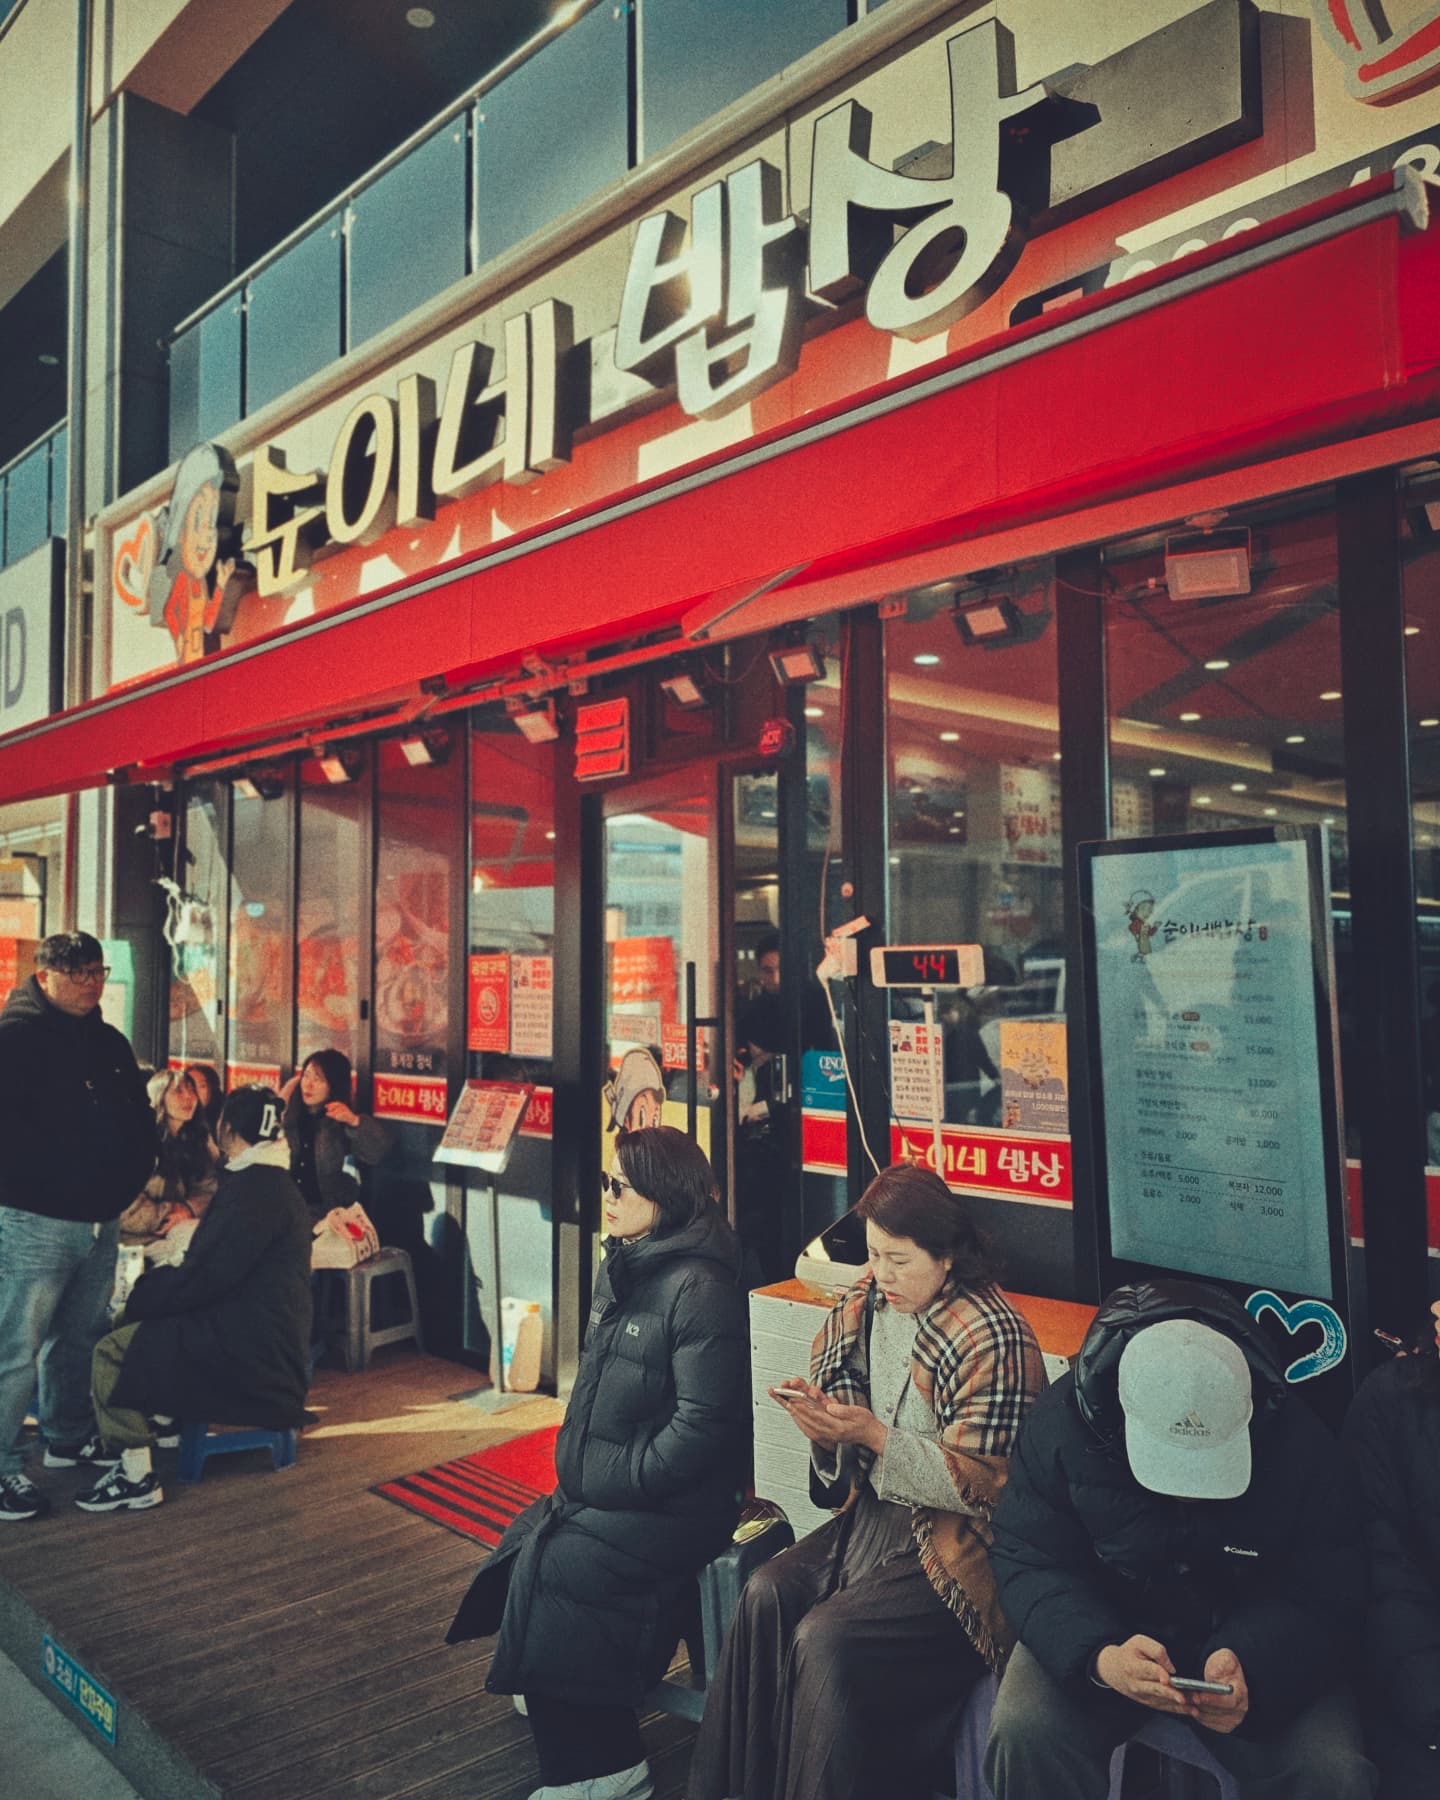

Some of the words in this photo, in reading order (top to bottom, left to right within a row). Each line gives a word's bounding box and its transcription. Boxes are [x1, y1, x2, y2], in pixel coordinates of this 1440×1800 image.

[242, 298, 572, 597] 순이네
[614, 17, 1055, 418] 밥상
[0, 605, 27, 710] D
[913, 953, 946, 981] 44
[996, 1146, 1064, 1187] 밥상
[1178, 1174, 1200, 1185] 5,000
[1254, 1185, 1284, 1197] 12,000
[1179, 1193, 1201, 1205] 2,000
[1260, 1206, 1285, 1217] 3,000
[625, 1321, 640, 1338] K2
[1169, 1426, 1211, 1438] adidas
